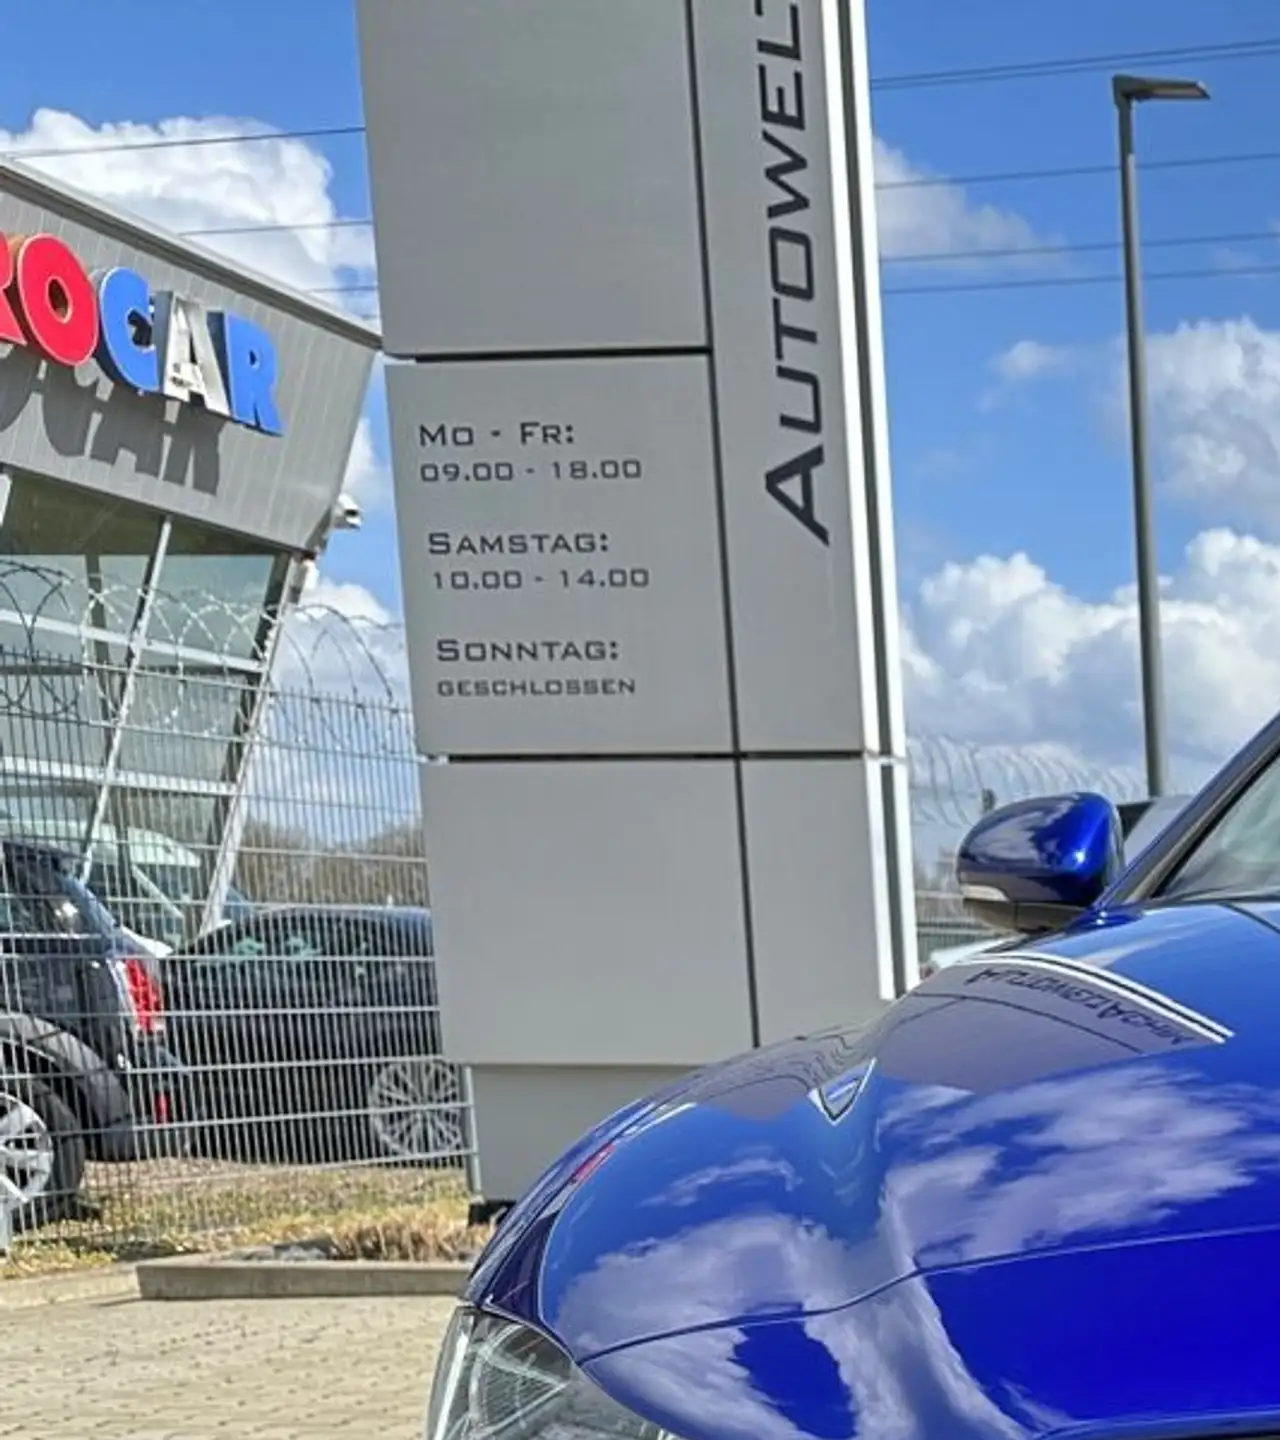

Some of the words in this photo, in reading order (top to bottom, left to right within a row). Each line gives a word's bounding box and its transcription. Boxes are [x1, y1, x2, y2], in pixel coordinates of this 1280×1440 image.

[755, 0, 830, 547] AUTOWEL
[418, 423, 475, 447] MO
[519, 421, 575, 446] FR:
[420, 461, 514, 483] 09.00
[552, 459, 643, 480] 18.00
[427, 532, 609, 555] SAMSTAG:
[433, 570, 523, 590] 10.00
[559, 568, 651, 589] 14.00
[436, 638, 619, 663] SONNTAG:
[437, 678, 637, 698] GESCHLOSSEN
